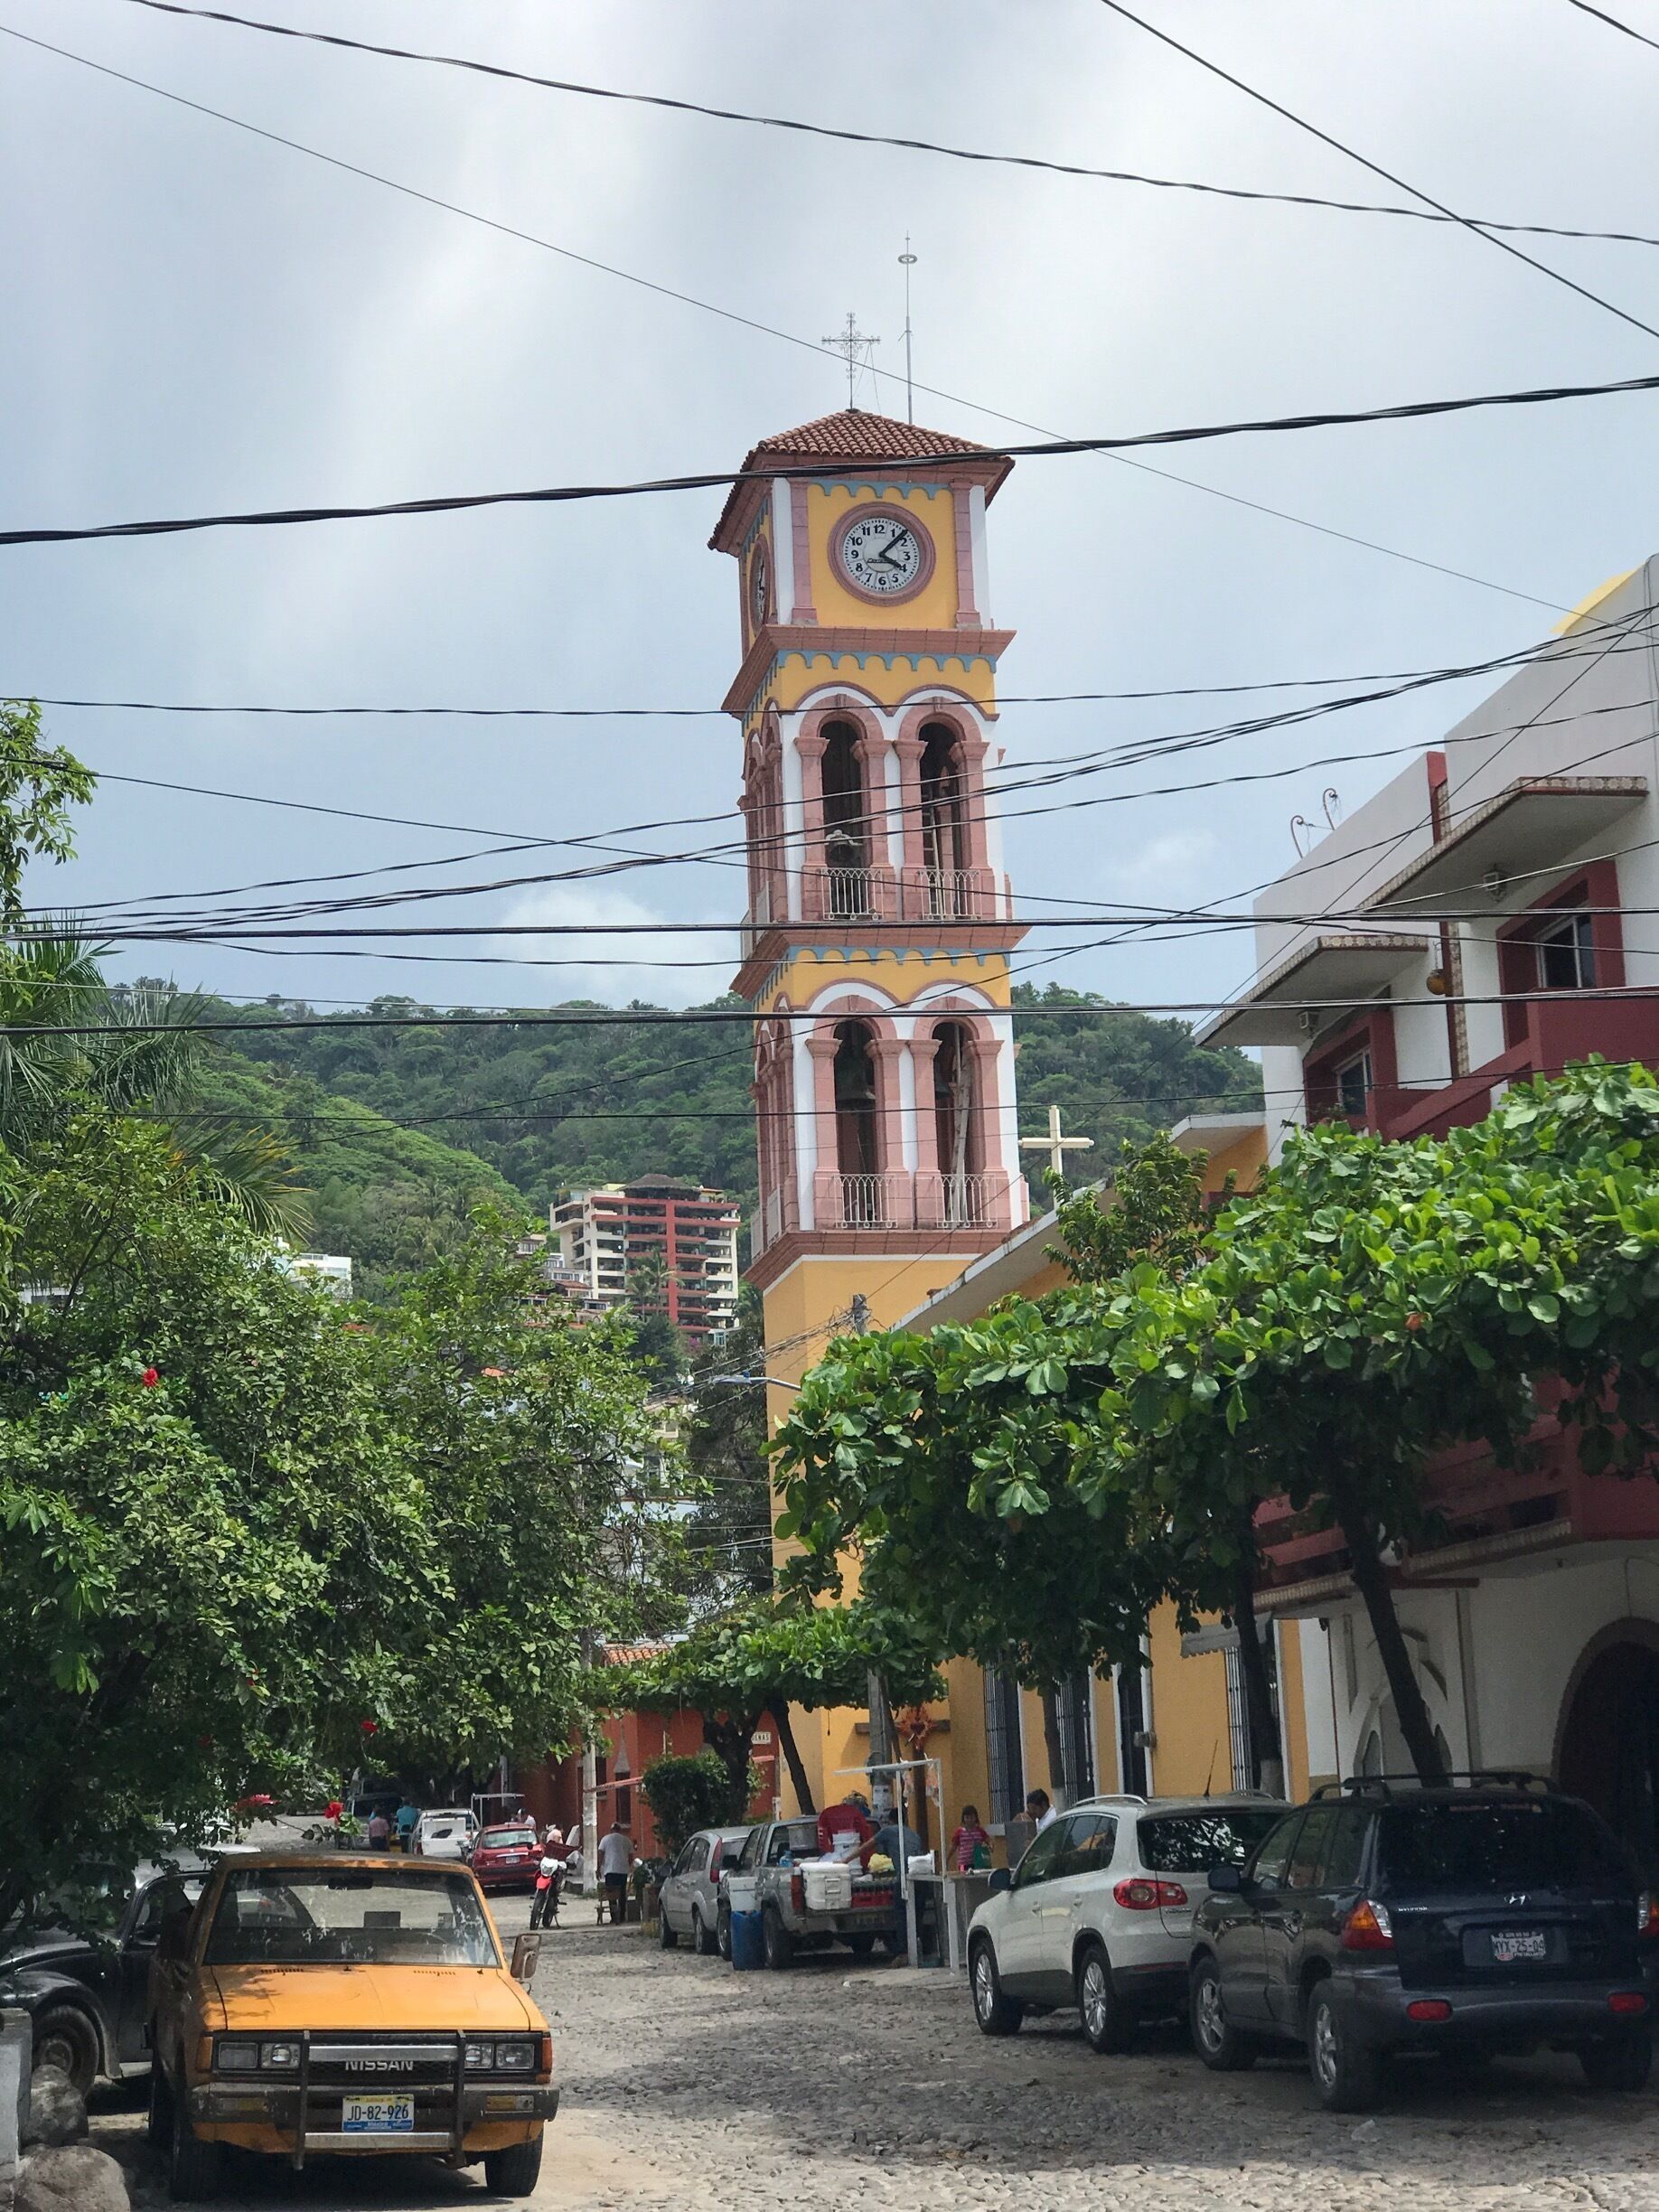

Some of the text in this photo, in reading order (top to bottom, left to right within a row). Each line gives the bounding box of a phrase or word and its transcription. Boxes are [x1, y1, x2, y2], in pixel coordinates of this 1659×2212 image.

[862, 526, 870, 536] 11
[874, 524, 886, 534] 12
[890, 529, 895, 538] 1
[851, 537, 863, 546] 10
[901, 538, 908, 547] 2
[851, 550, 858, 559] 9
[904, 551, 911, 561] 3
[856, 563, 863, 572] 8
[900, 563, 907, 573] 4
[866, 573, 873, 583] 7
[878, 576, 886, 586] 6
[892, 573, 899, 583] 5
[345, 2060, 414, 2071] NISSAN
[347, 2104, 409, 2121] JD-82-926
